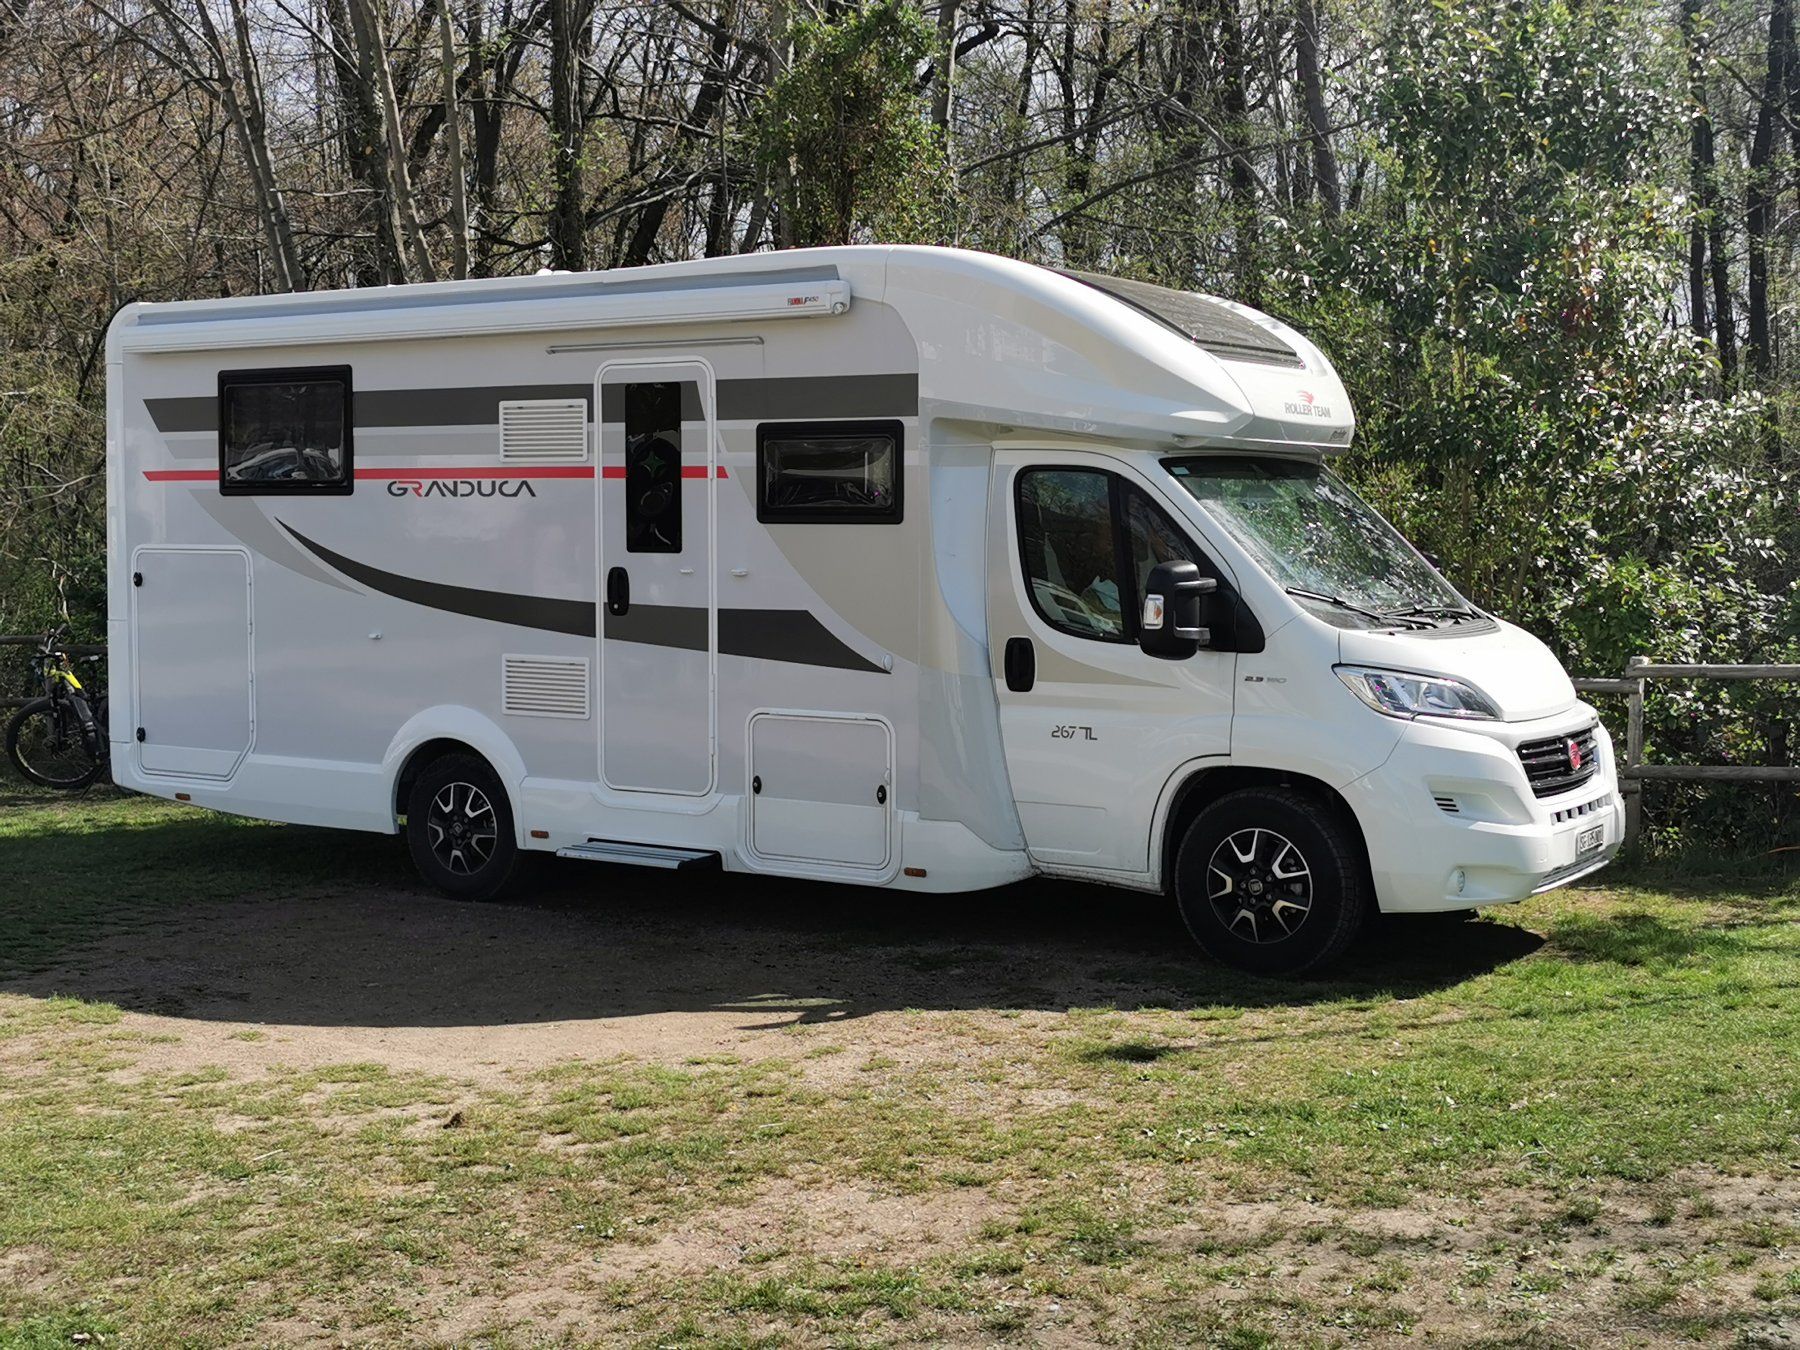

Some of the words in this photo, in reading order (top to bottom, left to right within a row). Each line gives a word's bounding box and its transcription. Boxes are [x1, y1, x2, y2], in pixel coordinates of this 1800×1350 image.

[1285, 403, 1312, 416] ROLLER
[1312, 405, 1332, 418] TEAM
[387, 480, 537, 497] GRANDUCA
[1051, 725, 1077, 739] 267
[1078, 726, 1098, 740] TL
